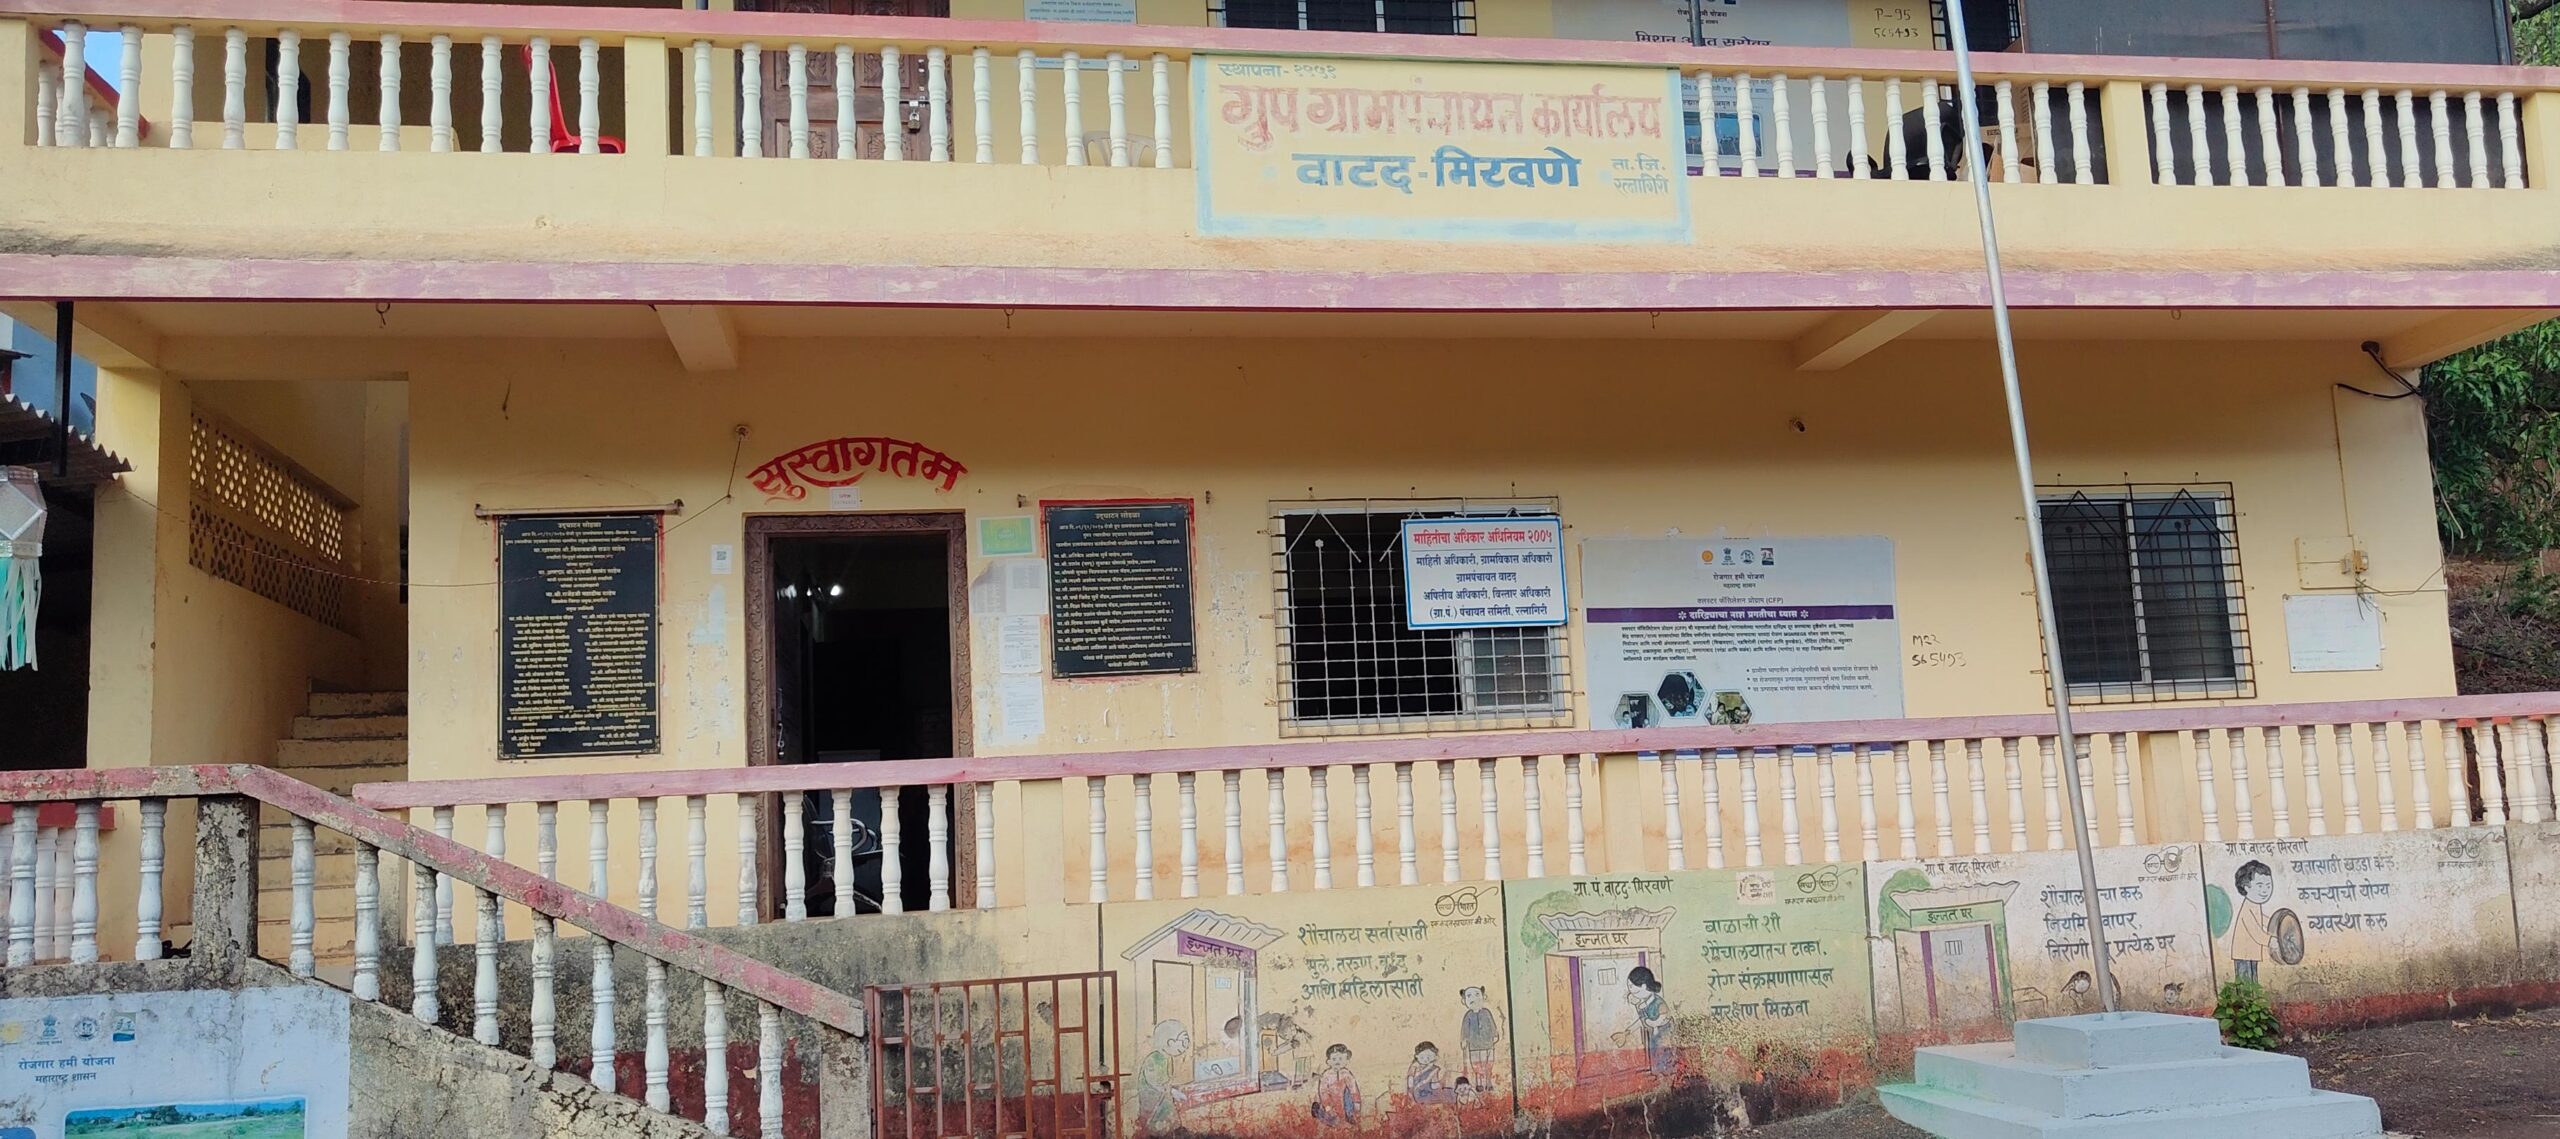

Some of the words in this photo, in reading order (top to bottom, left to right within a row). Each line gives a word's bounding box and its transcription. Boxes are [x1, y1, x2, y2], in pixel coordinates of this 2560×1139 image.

[1636, 30, 1676, 43] मिशन
[1307, 76, 1524, 136] ग्रामपंचायत
[1531, 82, 1663, 140] कार्यालय
[1613, 173, 1669, 195] रत्नागिरी
[746, 437, 968, 504] सुस्वागतम
[1413, 529, 1450, 547] माहितीचा
[1453, 529, 1484, 545] अधिकार
[1487, 528, 1525, 544] अधिनियम
[1528, 529, 1552, 544] २००५
[1416, 554, 1442, 568] माहिती
[1444, 553, 1478, 566] अधिकारी,
[1481, 552, 1519, 565] ग्रामविकास
[1522, 552, 1553, 564] अधिकारी
[1456, 570, 1496, 583] ग्रामपंचायत
[1499, 571, 1517, 583] वाटद
[1713, 572, 1732, 580] रोजगार
[1747, 571, 1765, 580] योजना
[1424, 588, 1452, 601] अपिलीय
[1456, 587, 1490, 600] अधिकारी,
[1492, 586, 1517, 598] विस्तार
[1520, 585, 1551, 598] अधिकारी
[1460, 604, 1486, 617] पंचायत
[1488, 604, 1513, 616] समिती,
[1516, 602, 1548, 615] रत्नागिरी
[1730, 610, 1745, 619] नाश
[1747, 608, 1776, 619] प्रगतीचा
[1779, 609, 1798, 618] ध्यास
[2290, 853, 2341, 875] खतासाठी
[2359, 878, 2390, 901] योग्य
[1703, 913, 1759, 935] बाळाची
[1761, 912, 1781, 934] शी
[1927, 909, 1957, 922] इज्जत
[1959, 908, 1973, 920] घर
[2043, 912, 2089, 933] नियमि
[2307, 912, 2362, 934] व्यवस्था
[1185, 936, 1223, 957] इज्जत
[1226, 946, 1243, 961] घर
[1575, 932, 1610, 948] इज्जत
[1611, 932, 1629, 945] घर
[2045, 937, 2089, 963] निरोगी
[2113, 933, 2154, 958] प्रत्येक
[2155, 934, 2177, 954] घर
[1301, 978, 1336, 1001] आणि
[1340, 973, 1424, 1004] महिलासाठी
[1707, 968, 1736, 992] रोग
[1738, 966, 1835, 992] संक्रमणापासून
[1710, 996, 1760, 1022] संरक्षण
[1762, 997, 1810, 1020] मिळवा
[18, 1057, 54, 1071] रोजगार
[59, 1056, 77, 1069] हमी
[82, 1054, 116, 1067] योजना
[35, 1073, 68, 1085] महाराष्ट्र
[71, 1072, 97, 1082] शासन
